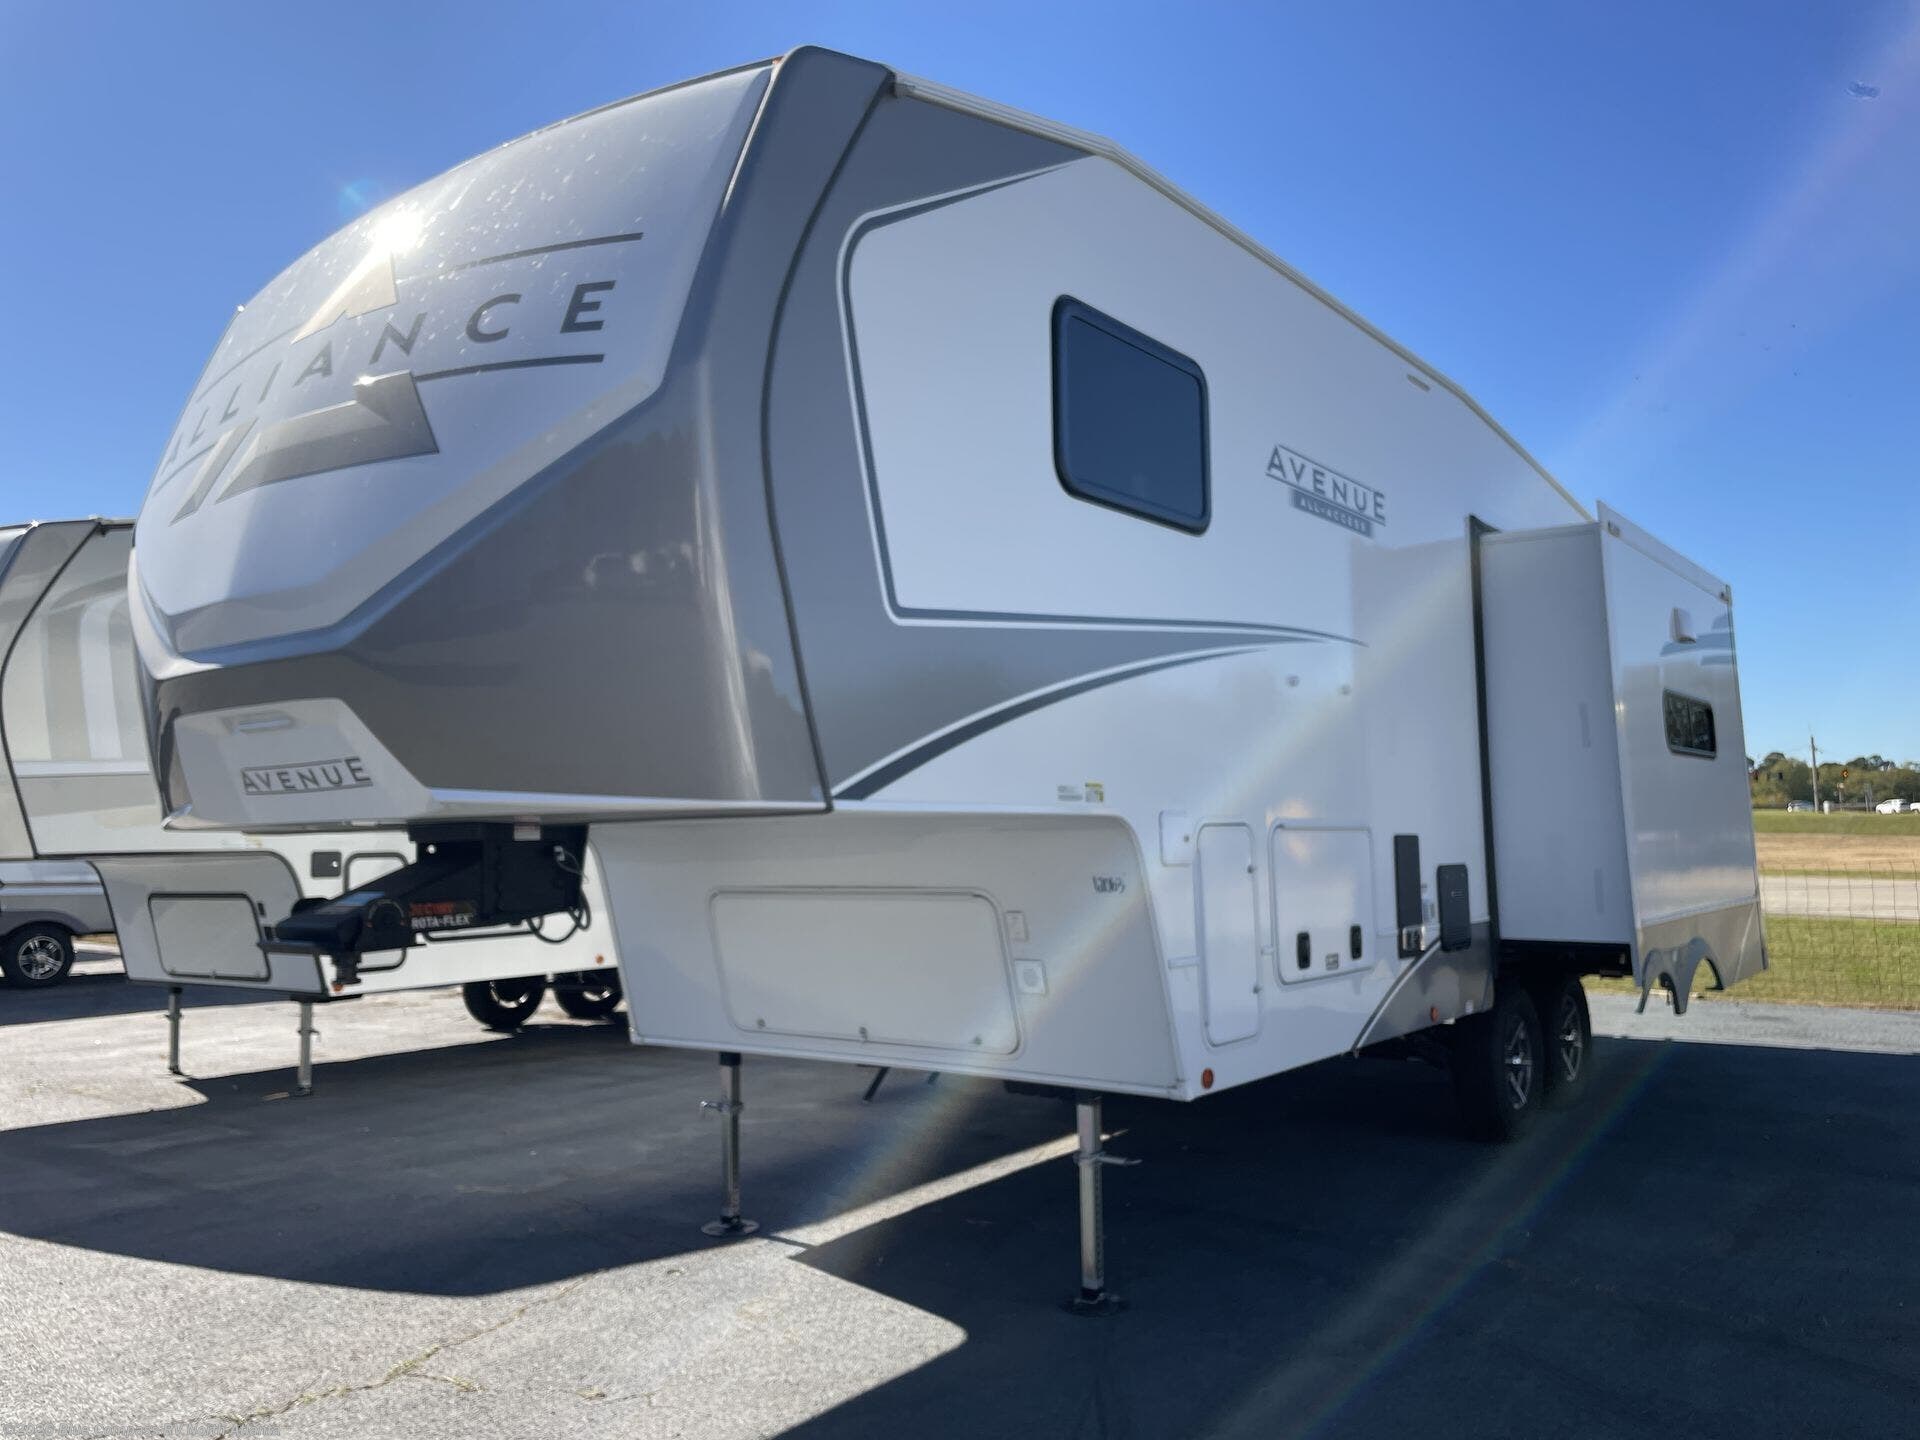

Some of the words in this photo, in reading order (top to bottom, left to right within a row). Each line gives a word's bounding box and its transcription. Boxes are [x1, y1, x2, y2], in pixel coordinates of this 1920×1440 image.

[160, 280, 616, 476] ALLIANCE
[1267, 445, 1386, 521] AVENUE
[241, 756, 372, 793] AVENUE
